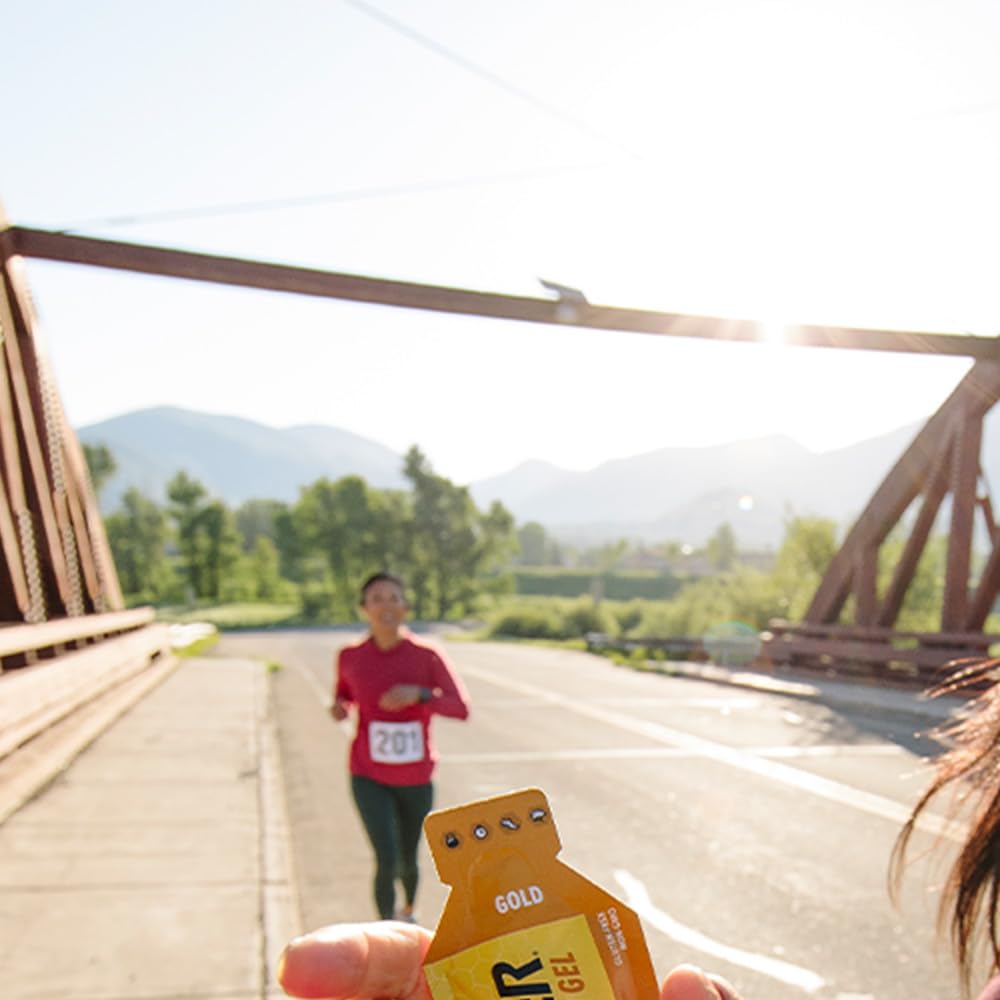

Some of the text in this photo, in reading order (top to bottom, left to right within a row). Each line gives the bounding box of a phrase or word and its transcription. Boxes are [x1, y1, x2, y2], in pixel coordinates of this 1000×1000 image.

[375, 728, 418, 755] 201
[494, 885, 544, 914] GOLD
[549, 951, 586, 993] GEL
